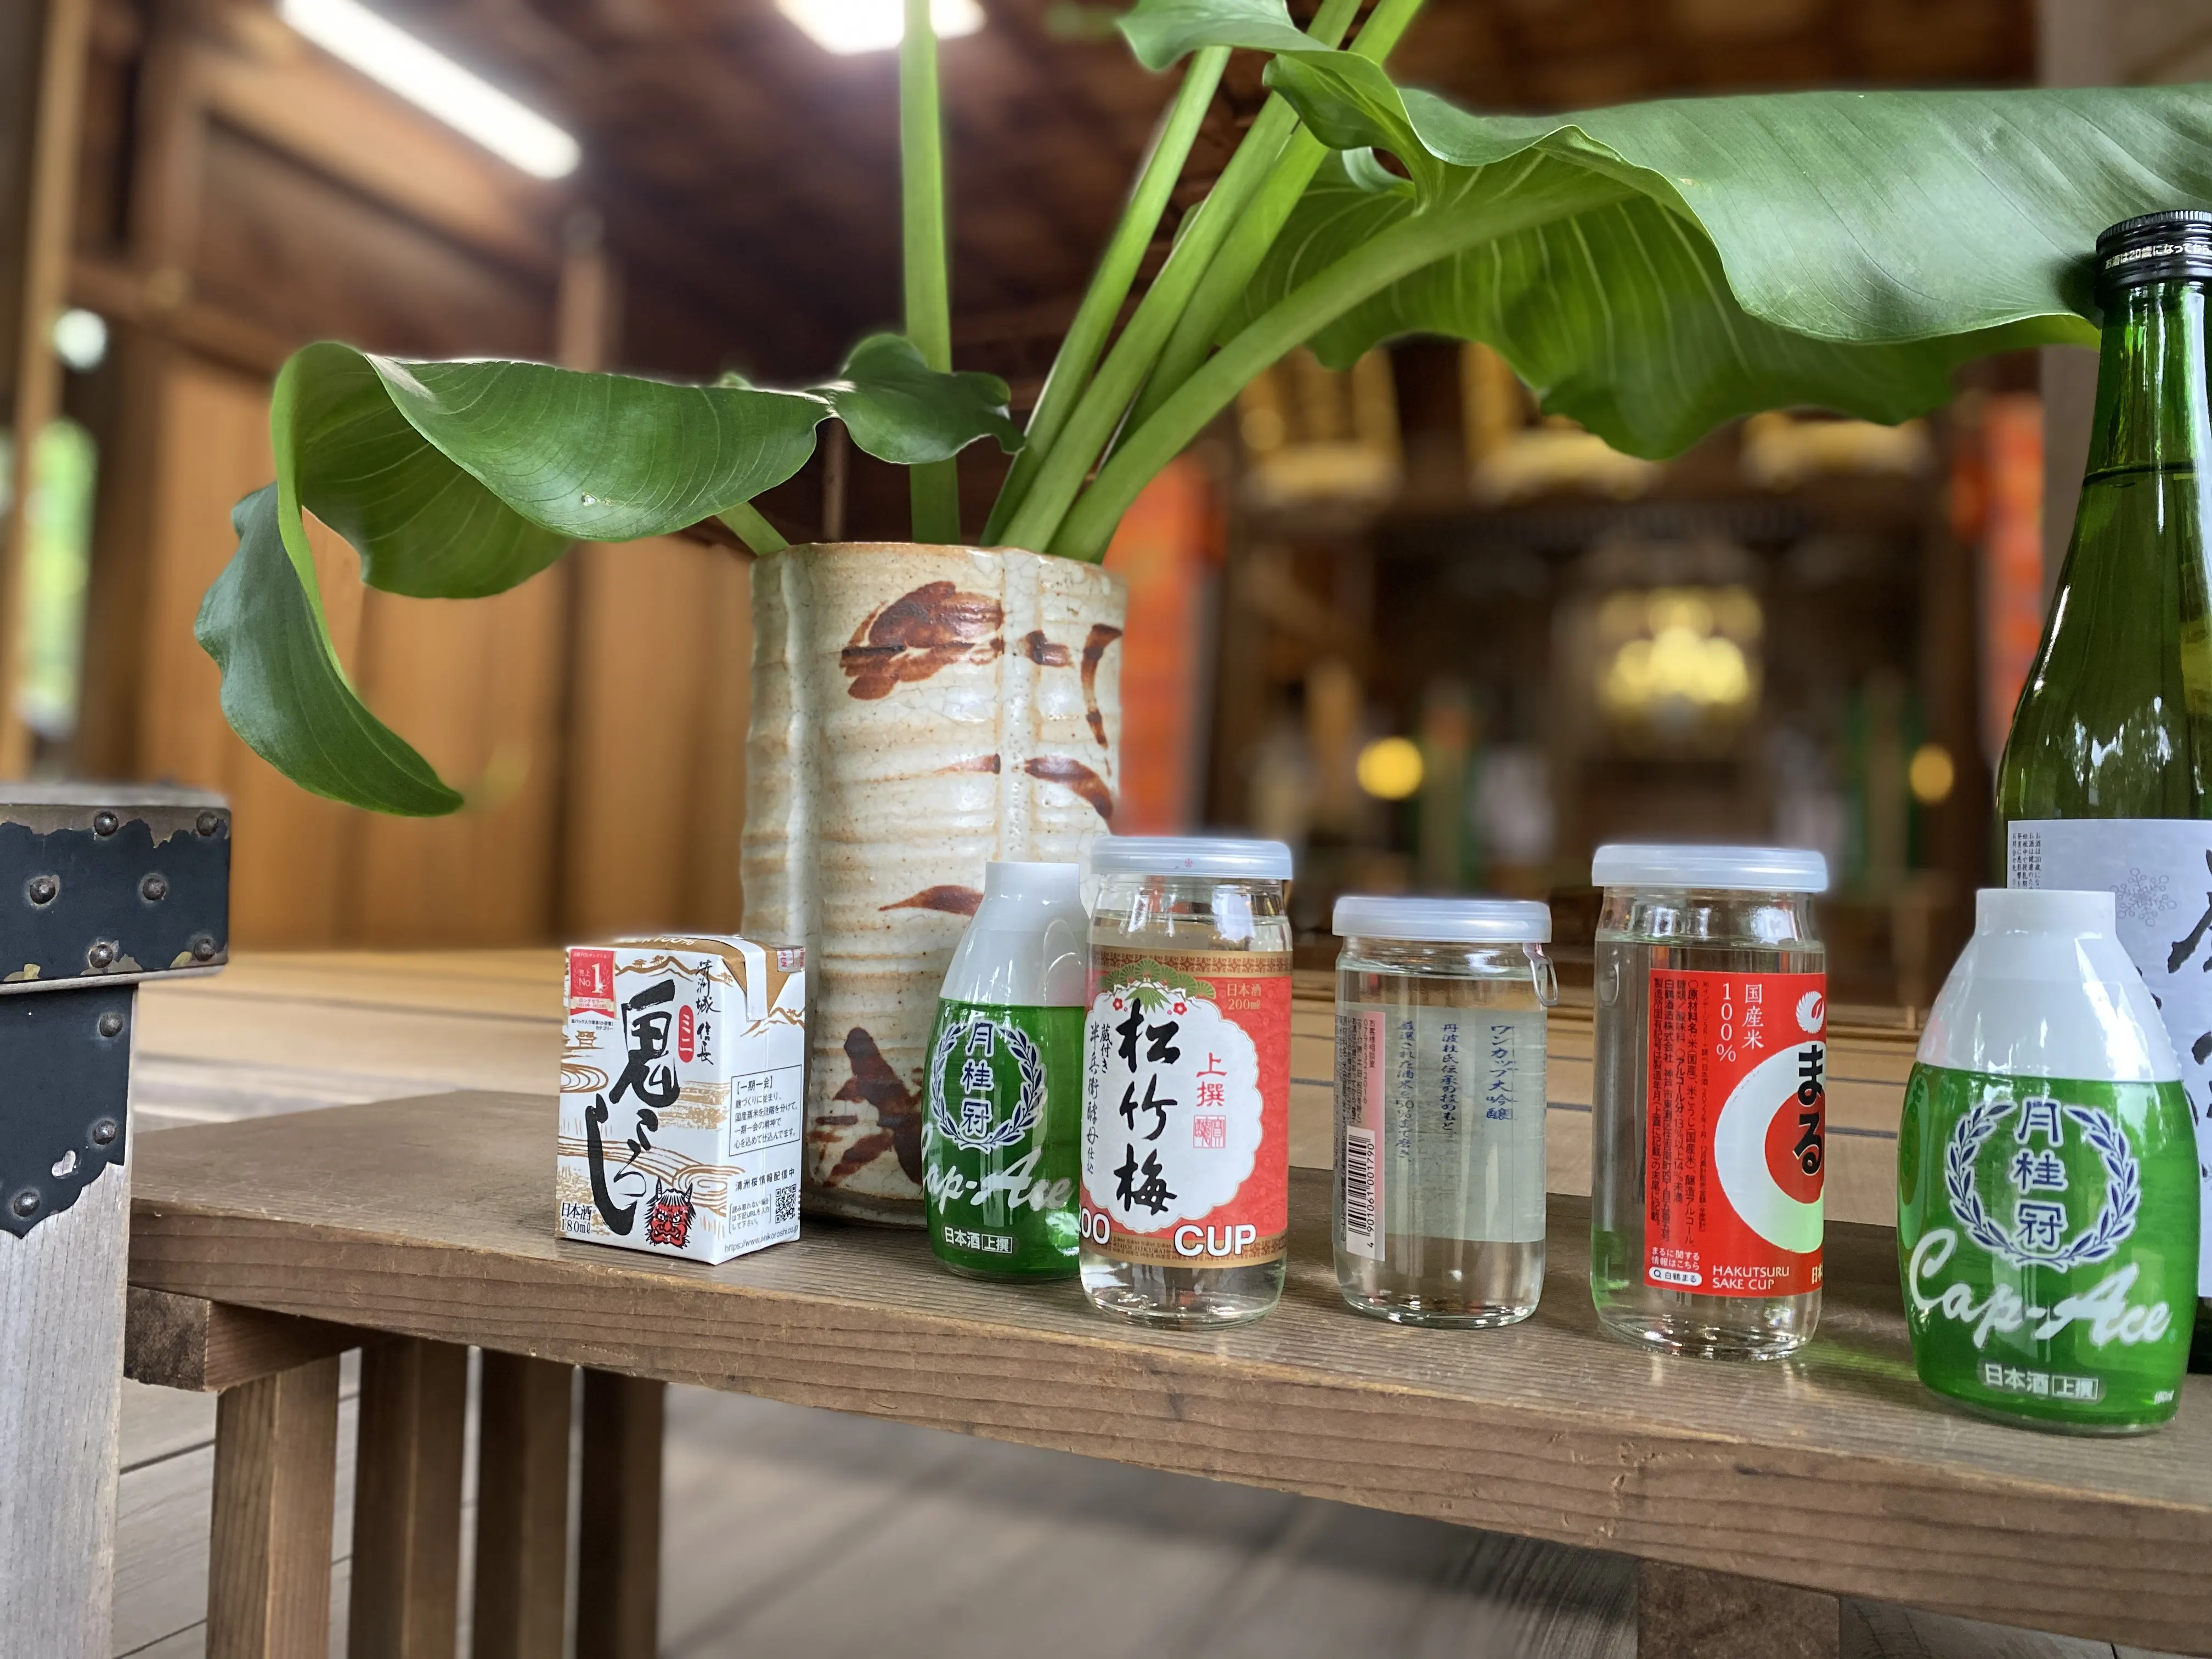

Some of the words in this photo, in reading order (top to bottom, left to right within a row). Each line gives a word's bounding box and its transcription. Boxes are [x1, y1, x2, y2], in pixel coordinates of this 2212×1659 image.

[579, 978, 591, 987] No
[1227, 983, 1262, 997] 日本酒
[679, 1014, 693, 1052] ミニ
[1716, 983, 1736, 1062] 100%
[1741, 983, 1764, 1051] 国産米
[1099, 1023, 1113, 1074] 蔵付き
[737, 1076, 772, 1094] 【一期一会】
[961, 1022, 995, 1136] 月桂冠
[1195, 1052, 1227, 1107] 上撰
[1114, 998, 1181, 1216] 松竹梅
[1792, 1043, 1825, 1177] まる
[2010, 1098, 2068, 1249] 月桂冠
[561, 1202, 592, 1221] 日本酒
[944, 1226, 980, 1250] 日本酒
[984, 1237, 1009, 1252] 上撰
[1173, 1223, 1257, 1257] CUP
[1652, 1246, 1700, 1261] まるに関する
[1651, 1256, 1700, 1271] 情報はこちら
[1664, 1271, 1697, 1283] 白鶴まる
[1712, 1265, 1790, 1278] HAKUTSURU
[1712, 1278, 1745, 1289] SAKE
[1748, 1279, 1774, 1290] CUP
[1909, 1228, 2171, 1348] Cap-Ace
[1985, 1363, 2050, 1395] 日本酒
